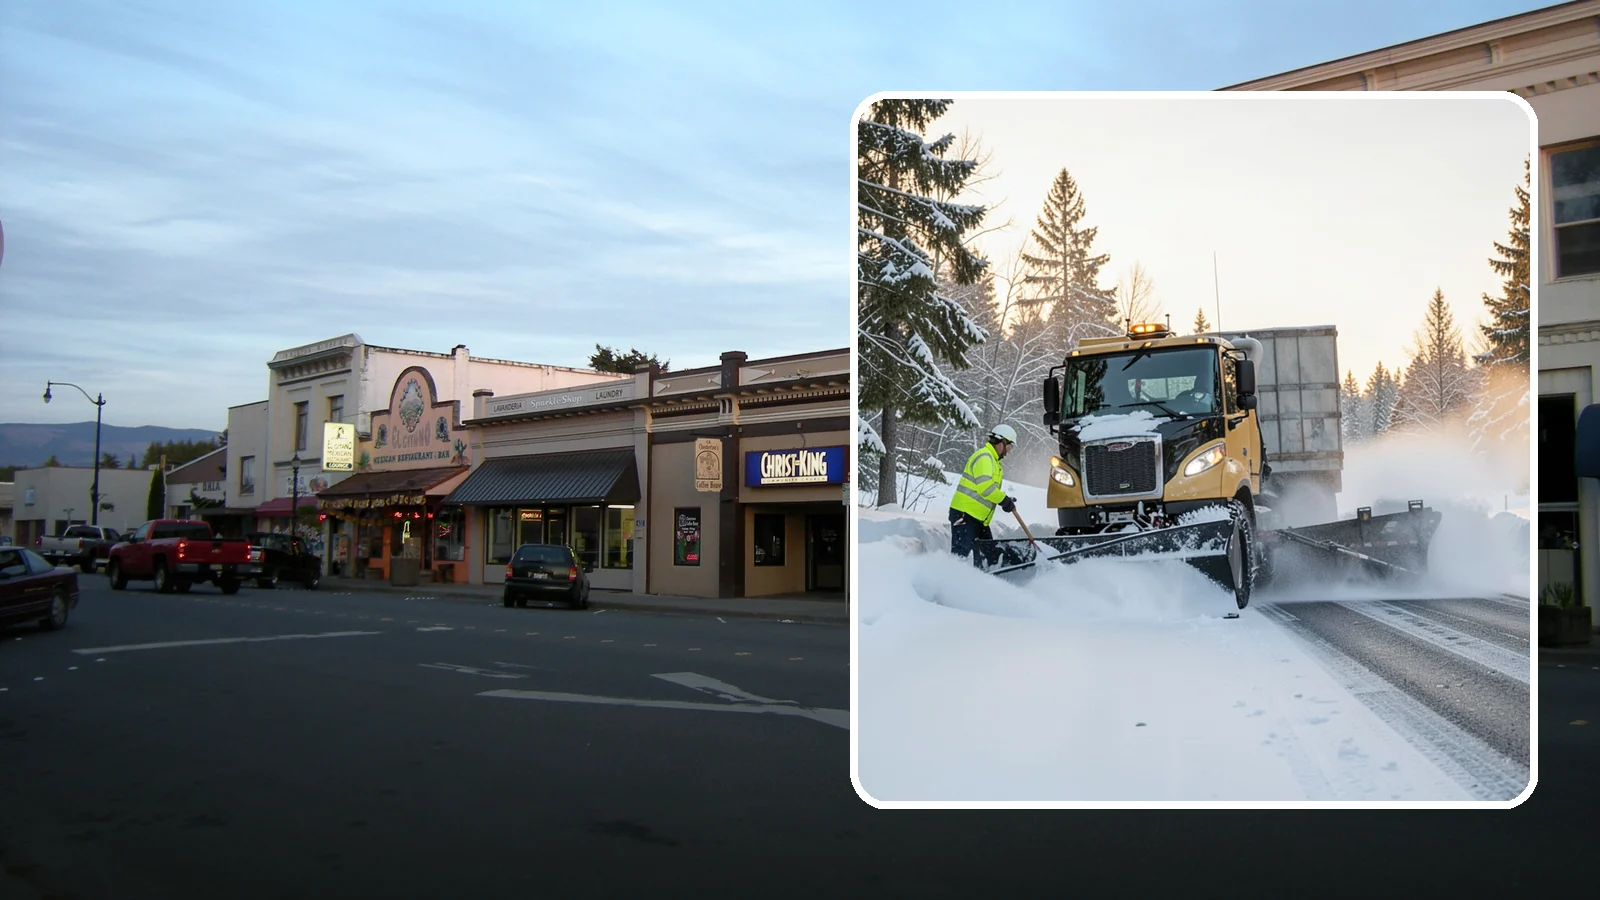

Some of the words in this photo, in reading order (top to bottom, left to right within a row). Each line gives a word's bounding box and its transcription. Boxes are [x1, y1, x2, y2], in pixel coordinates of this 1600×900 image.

[596, 389, 623, 400] LAUNDRY
[494, 402, 522, 412] LAVANDERIA
[531, 398, 561, 409] Sparkle
[562, 395, 582, 404] Shop
[374, 455, 396, 464] MEXICAN
[397, 451, 433, 462] RESTAURANT
[438, 450, 450, 459] BAR
[799, 450, 827, 476] KING
